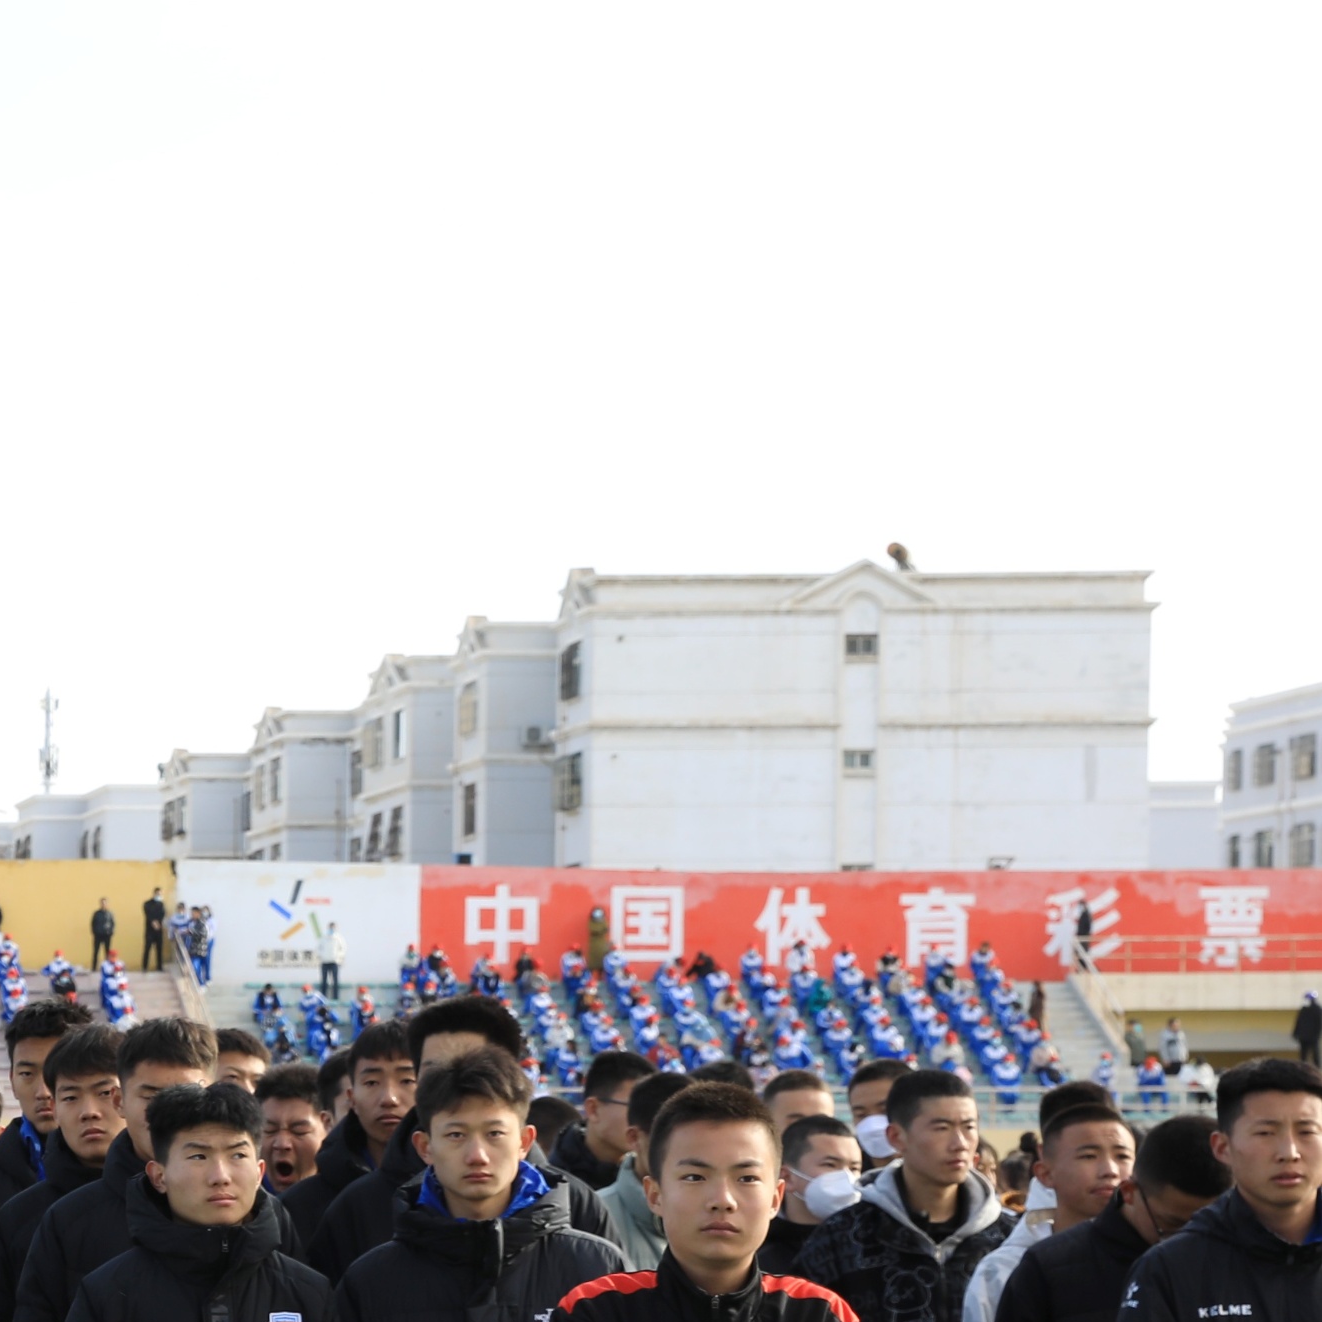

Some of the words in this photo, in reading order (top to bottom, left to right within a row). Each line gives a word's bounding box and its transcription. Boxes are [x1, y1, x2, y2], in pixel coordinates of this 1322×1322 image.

[464, 884, 1270, 967] 中国体育彩票
